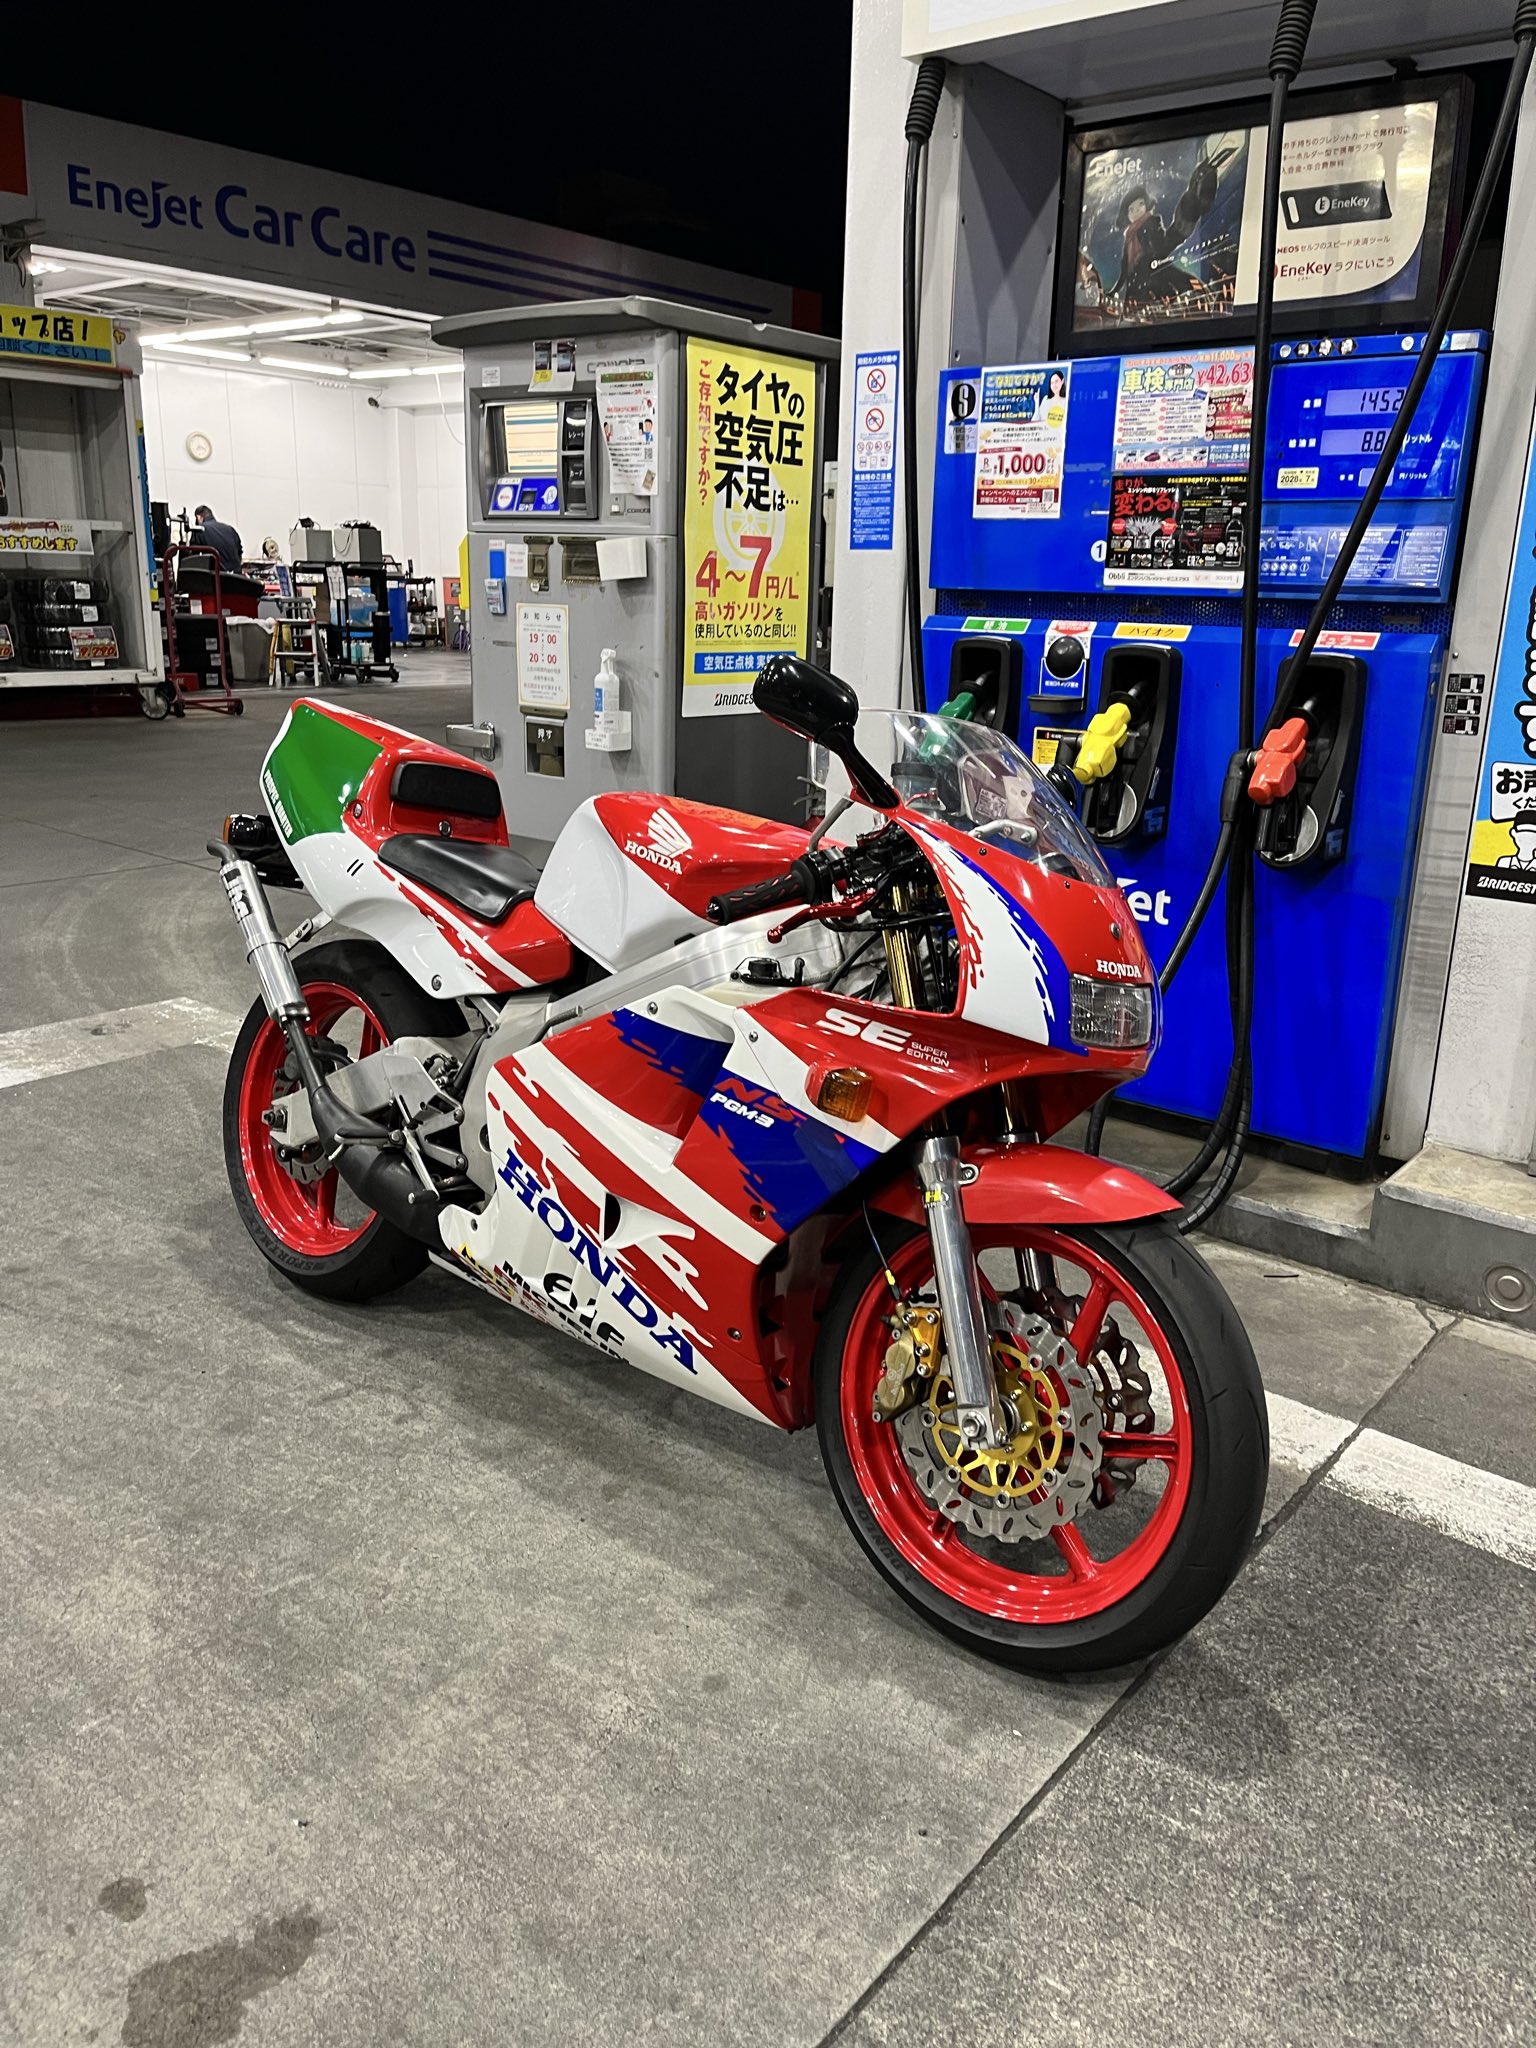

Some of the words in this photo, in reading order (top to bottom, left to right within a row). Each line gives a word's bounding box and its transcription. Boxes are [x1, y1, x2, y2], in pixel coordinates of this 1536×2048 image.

[1331, 195, 1370, 210] EneKey
[214, 185, 303, 248] Car
[311, 206, 417, 272] Care
[1280, 261, 1332, 278] EneKey
[1334, 256, 1395, 273] ラクにいこう
[0, 314, 89, 342] ップ店！
[1198, 362, 1254, 387] ¥42,63
[716, 362, 805, 419] タイヤの
[568, 431, 584, 439] レシート
[714, 411, 805, 467] 空気圧
[1095, 544, 1103, 561] 1
[523, 612, 562, 622] お知らせ
[694, 600, 784, 623] 高いガソリンを
[1129, 627, 1175, 637] ハイオク
[703, 655, 754, 671] 空気圧点検
[536, 727, 553, 741] 押す
[624, 838, 683, 876] HONDA
[1095, 958, 1142, 979] HONDA
[815, 1007, 914, 1053] SE
[906, 1048, 950, 1067] EDITION
[911, 1041, 948, 1059] SUPER
[498, 1148, 699, 1376] HONDA
